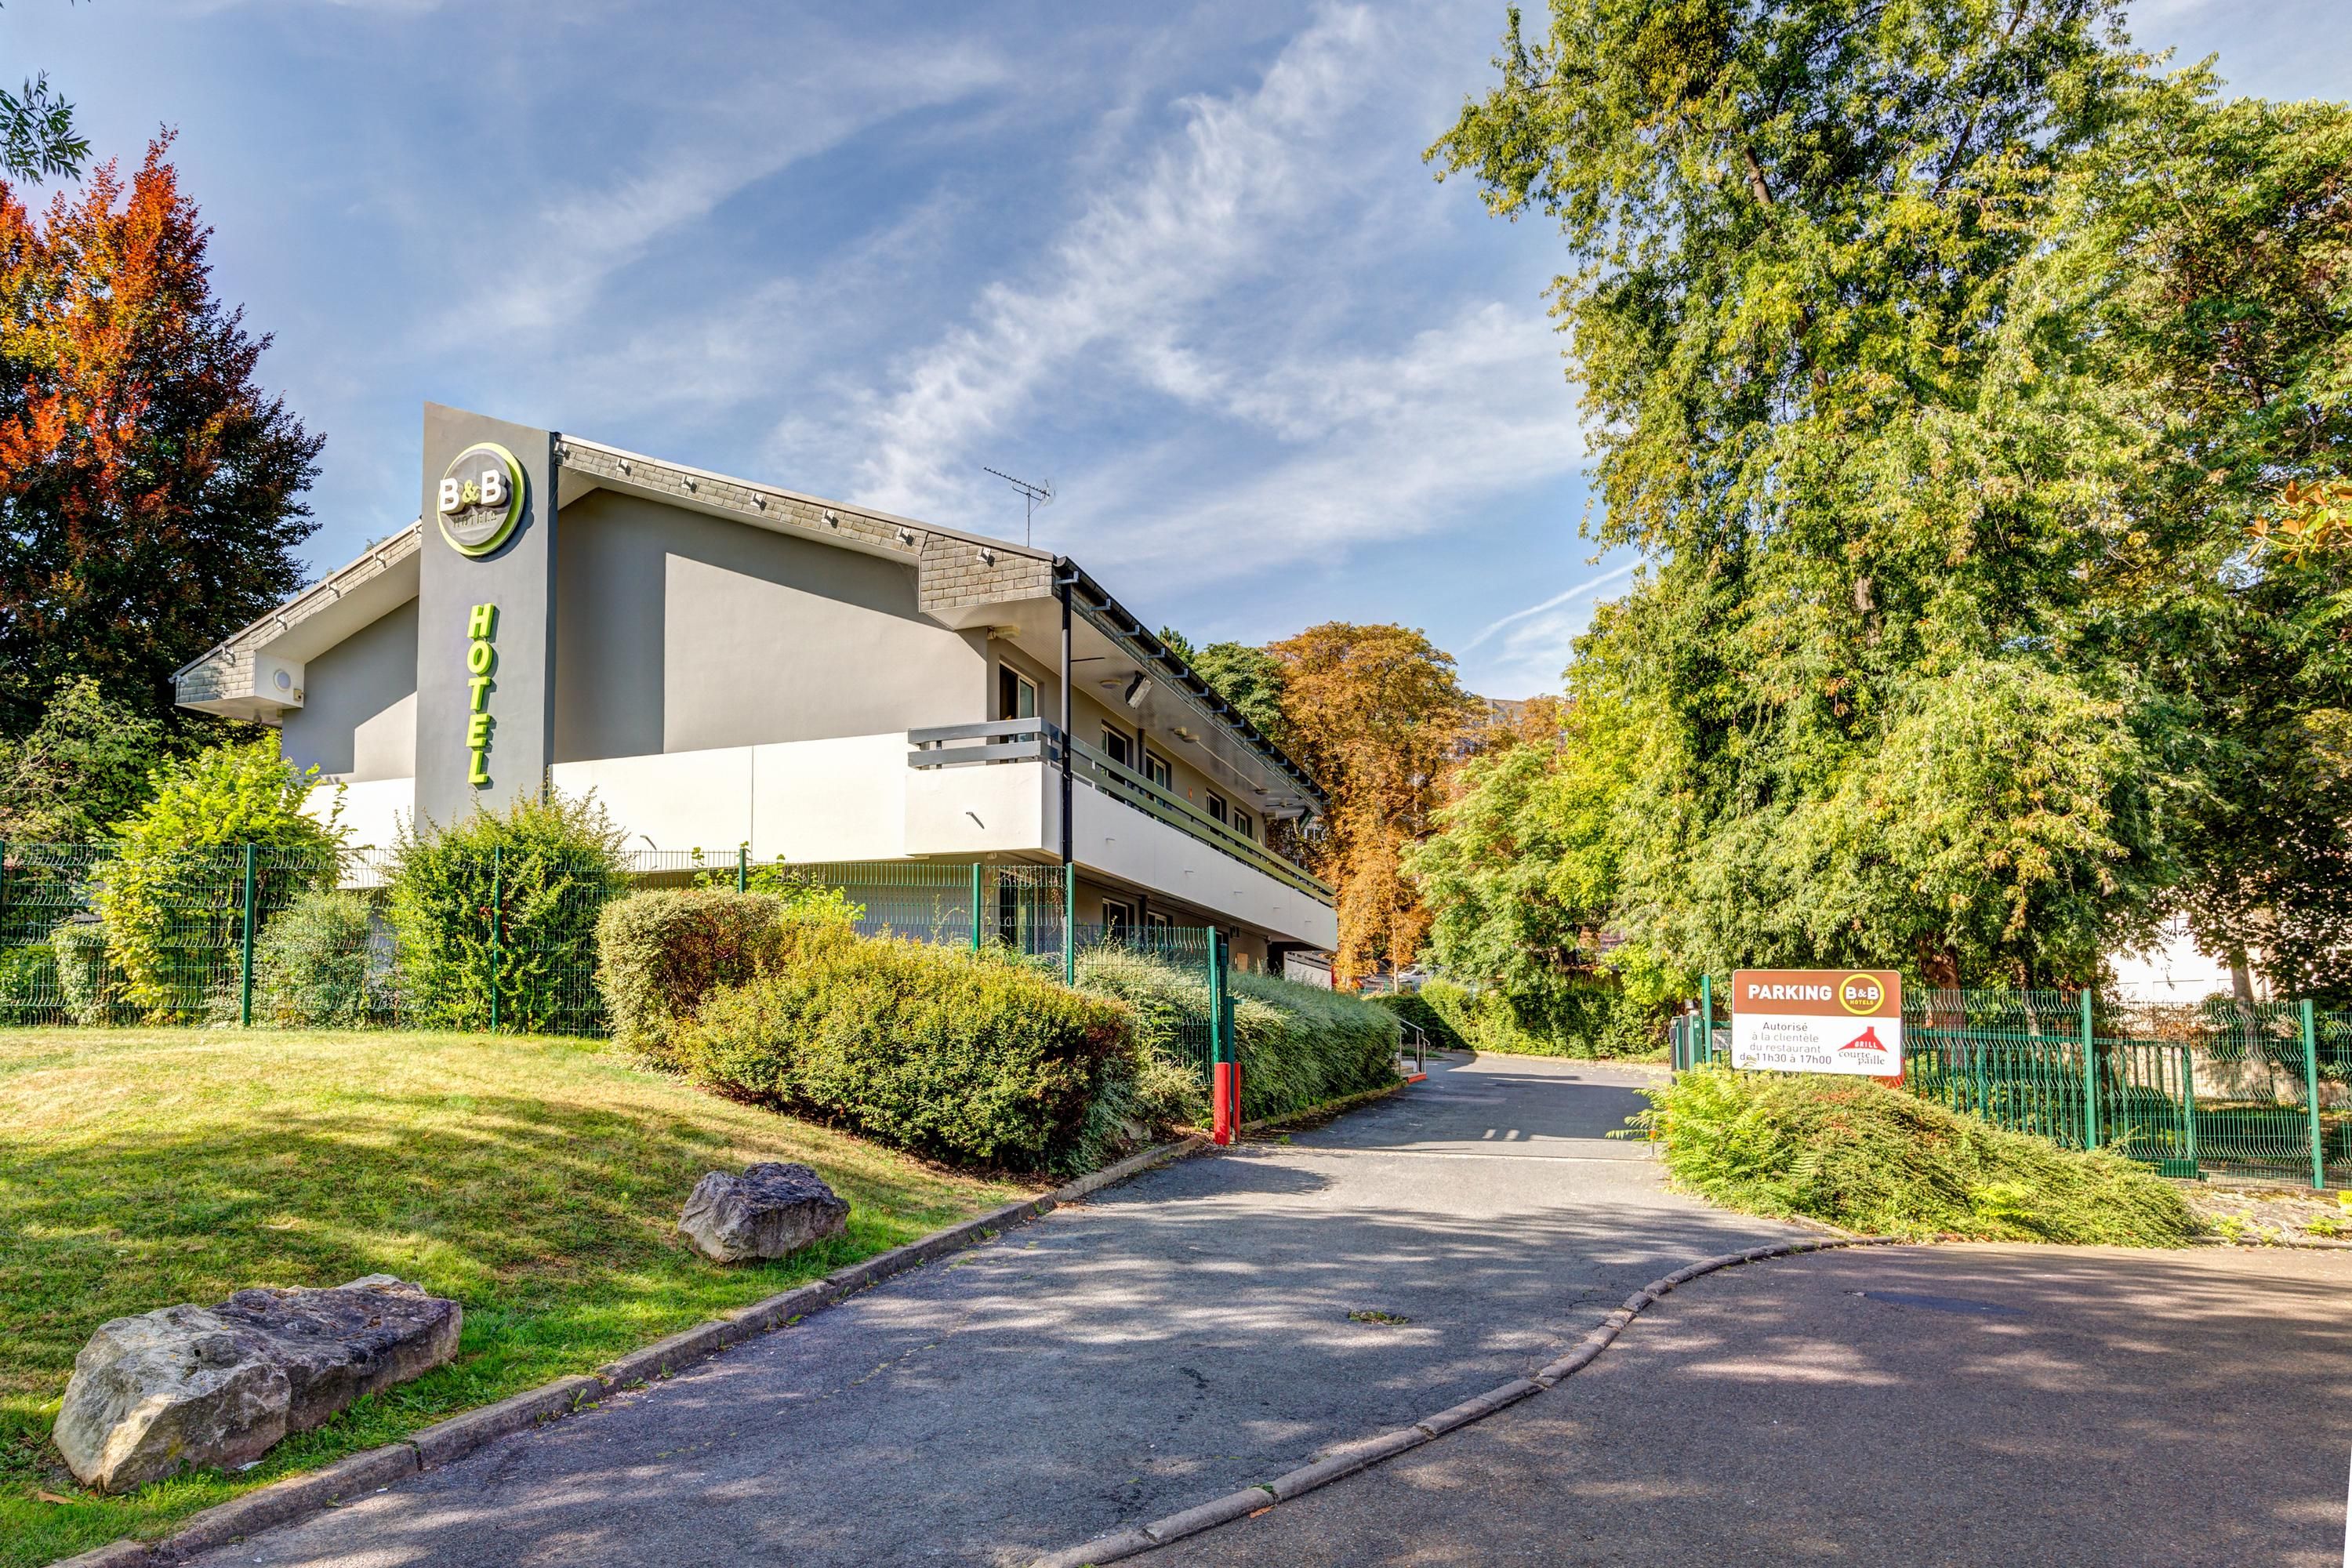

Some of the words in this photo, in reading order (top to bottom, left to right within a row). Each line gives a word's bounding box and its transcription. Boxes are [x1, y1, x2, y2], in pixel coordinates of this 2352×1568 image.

[439, 470, 503, 512] B&B
[466, 603, 495, 783] HOTEL
[1748, 984, 1832, 1001] PARKING
[1846, 986, 1879, 1000] B&B
[1762, 1022, 1808, 1032] Autorisé
[1751, 1032, 1758, 1040] à
[1761, 1032, 1770, 1041] la
[1773, 1033, 1819, 1043] clientèle
[1750, 1043, 1762, 1051] du
[1766, 1044, 1820, 1054] restaurant
[1756, 1053, 1787, 1063] 11h30
[1790, 1054, 1795, 1063] à
[1801, 1054, 1831, 1065] 17h00
[1858, 1054, 1885, 1065] paille
